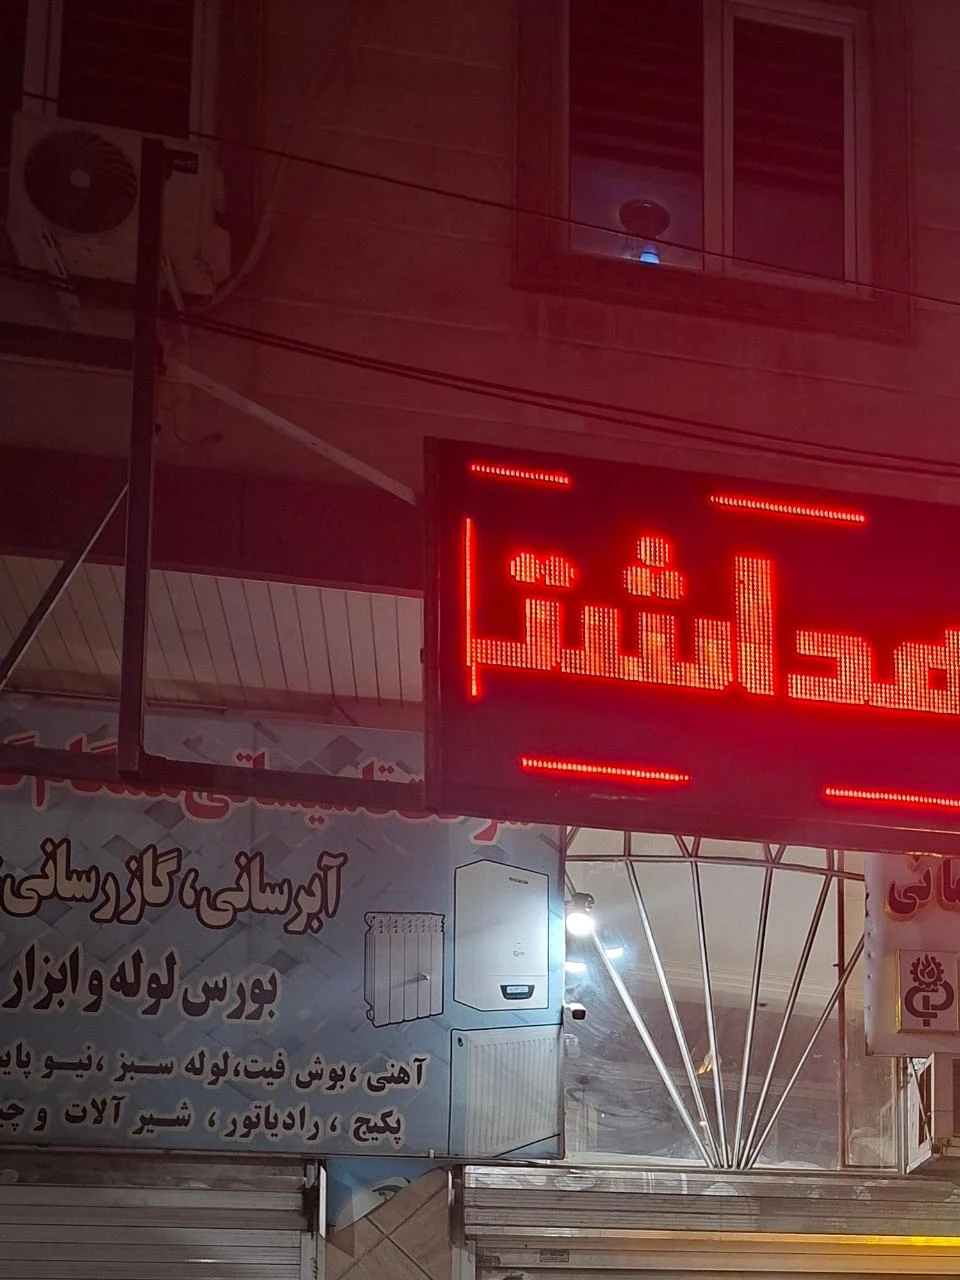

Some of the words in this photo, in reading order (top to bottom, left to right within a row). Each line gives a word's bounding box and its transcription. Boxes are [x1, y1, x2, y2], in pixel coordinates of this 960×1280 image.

[2, 944, 80, 1010] ابزار
[82, 969, 104, 1013] و
[110, 949, 178, 1016] لوله
[181, 971, 279, 1020] بورس
[184, 1049, 230, 1086] لوله
[64, 1095, 126, 1125] آلات
[131, 1101, 191, 1135] شیر
[224, 1104, 320, 1141] رادیاتور
[353, 1109, 401, 1144] پکیج
